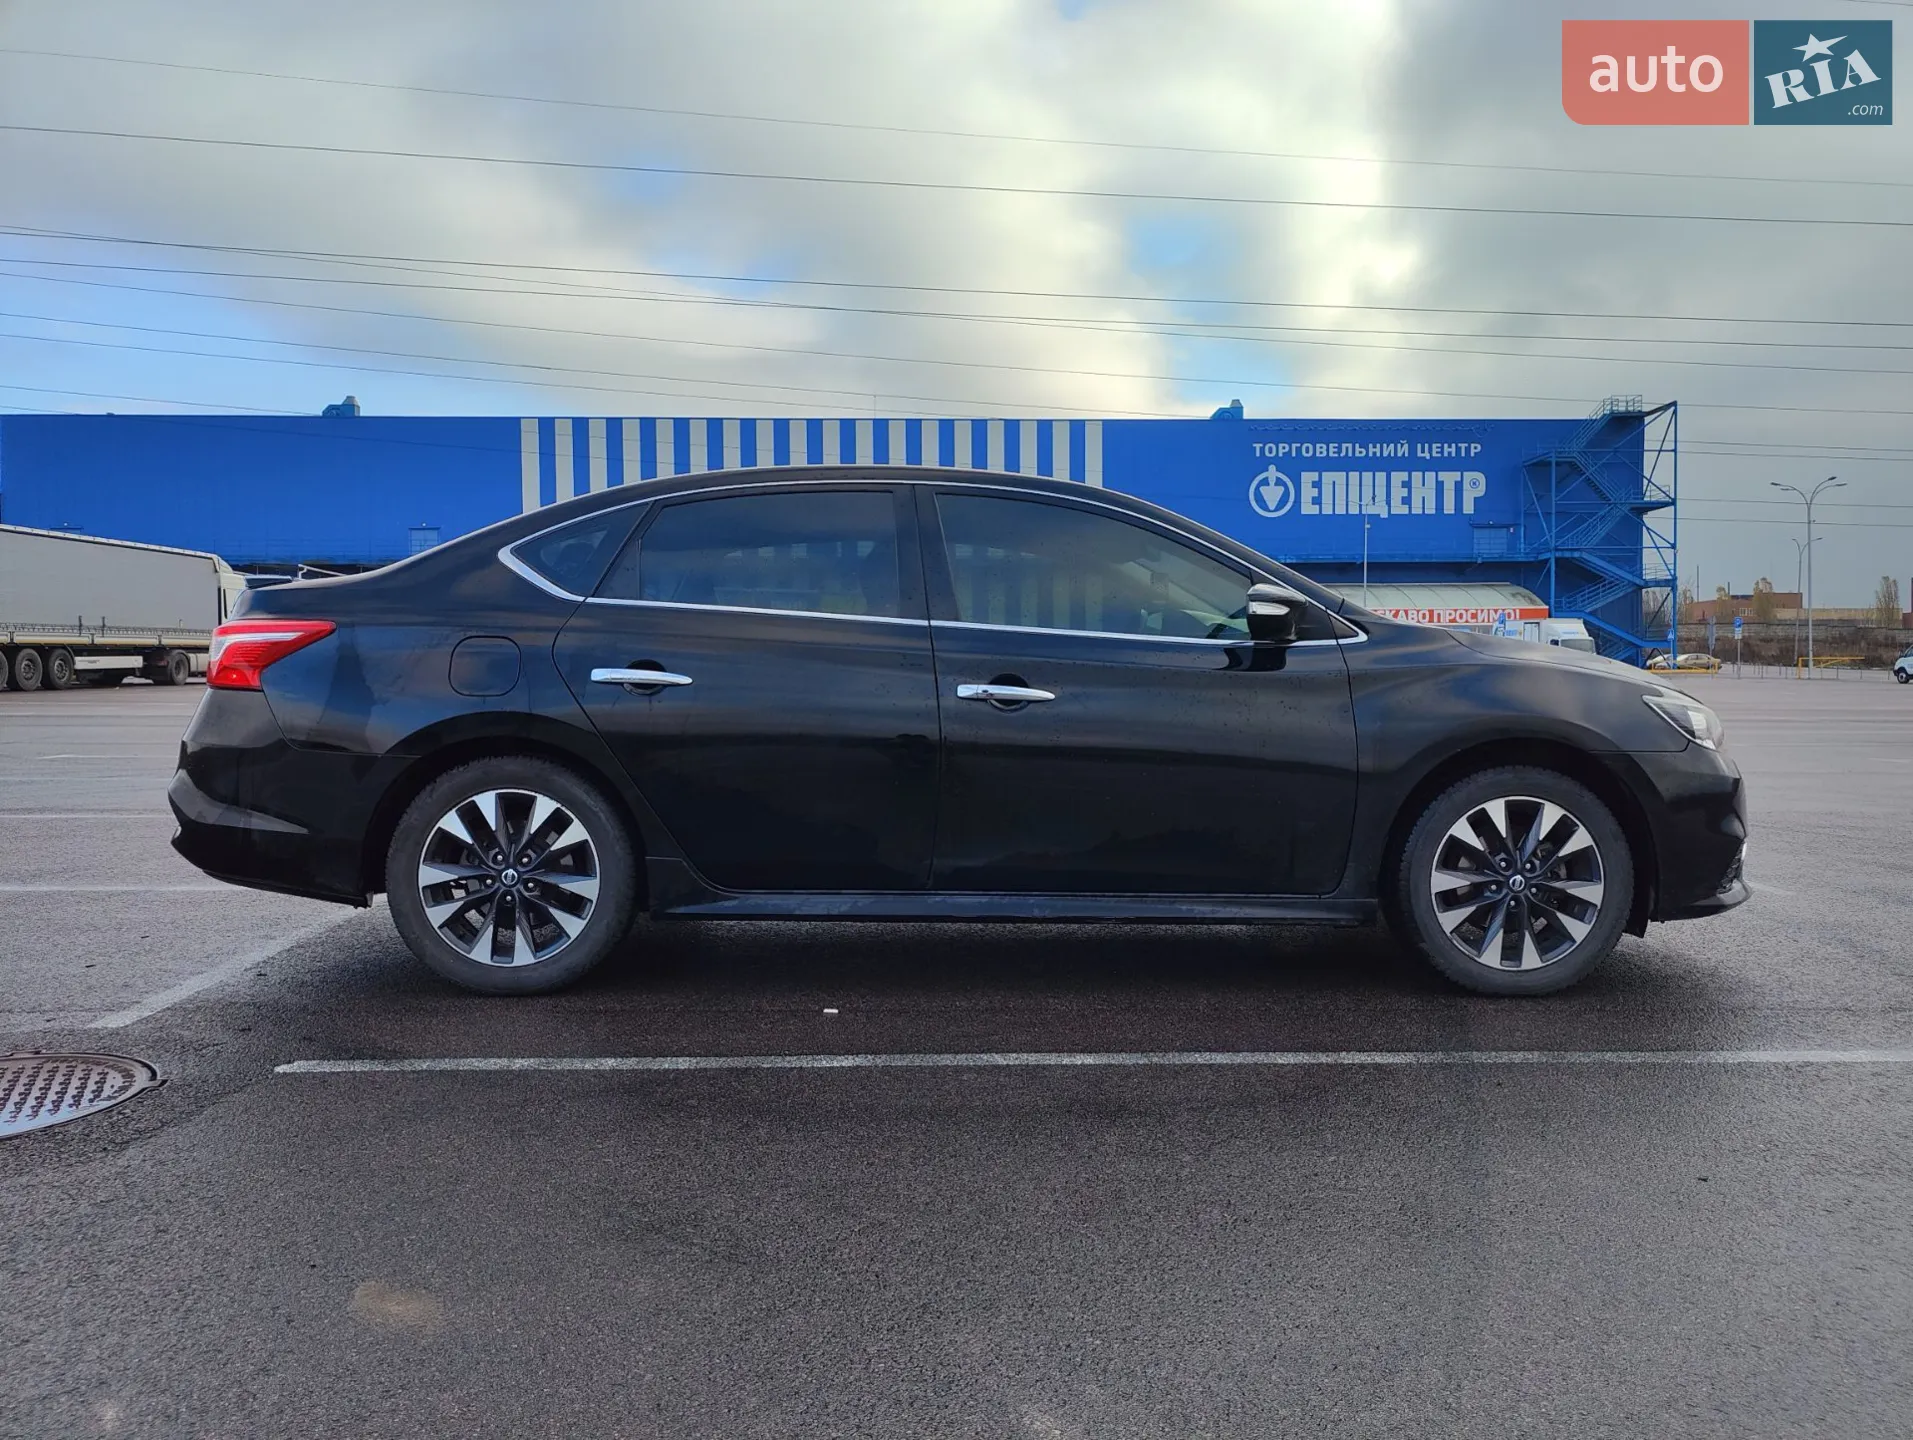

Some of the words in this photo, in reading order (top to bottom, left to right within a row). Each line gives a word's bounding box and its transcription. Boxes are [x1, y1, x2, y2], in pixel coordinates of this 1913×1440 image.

[1252, 440, 1409, 457] ТОРГОВЕЛЬНИЙ
[1417, 443, 1482, 460] ЦЕНТР
[1300, 471, 1486, 518] ЕПІЦЕНТР
